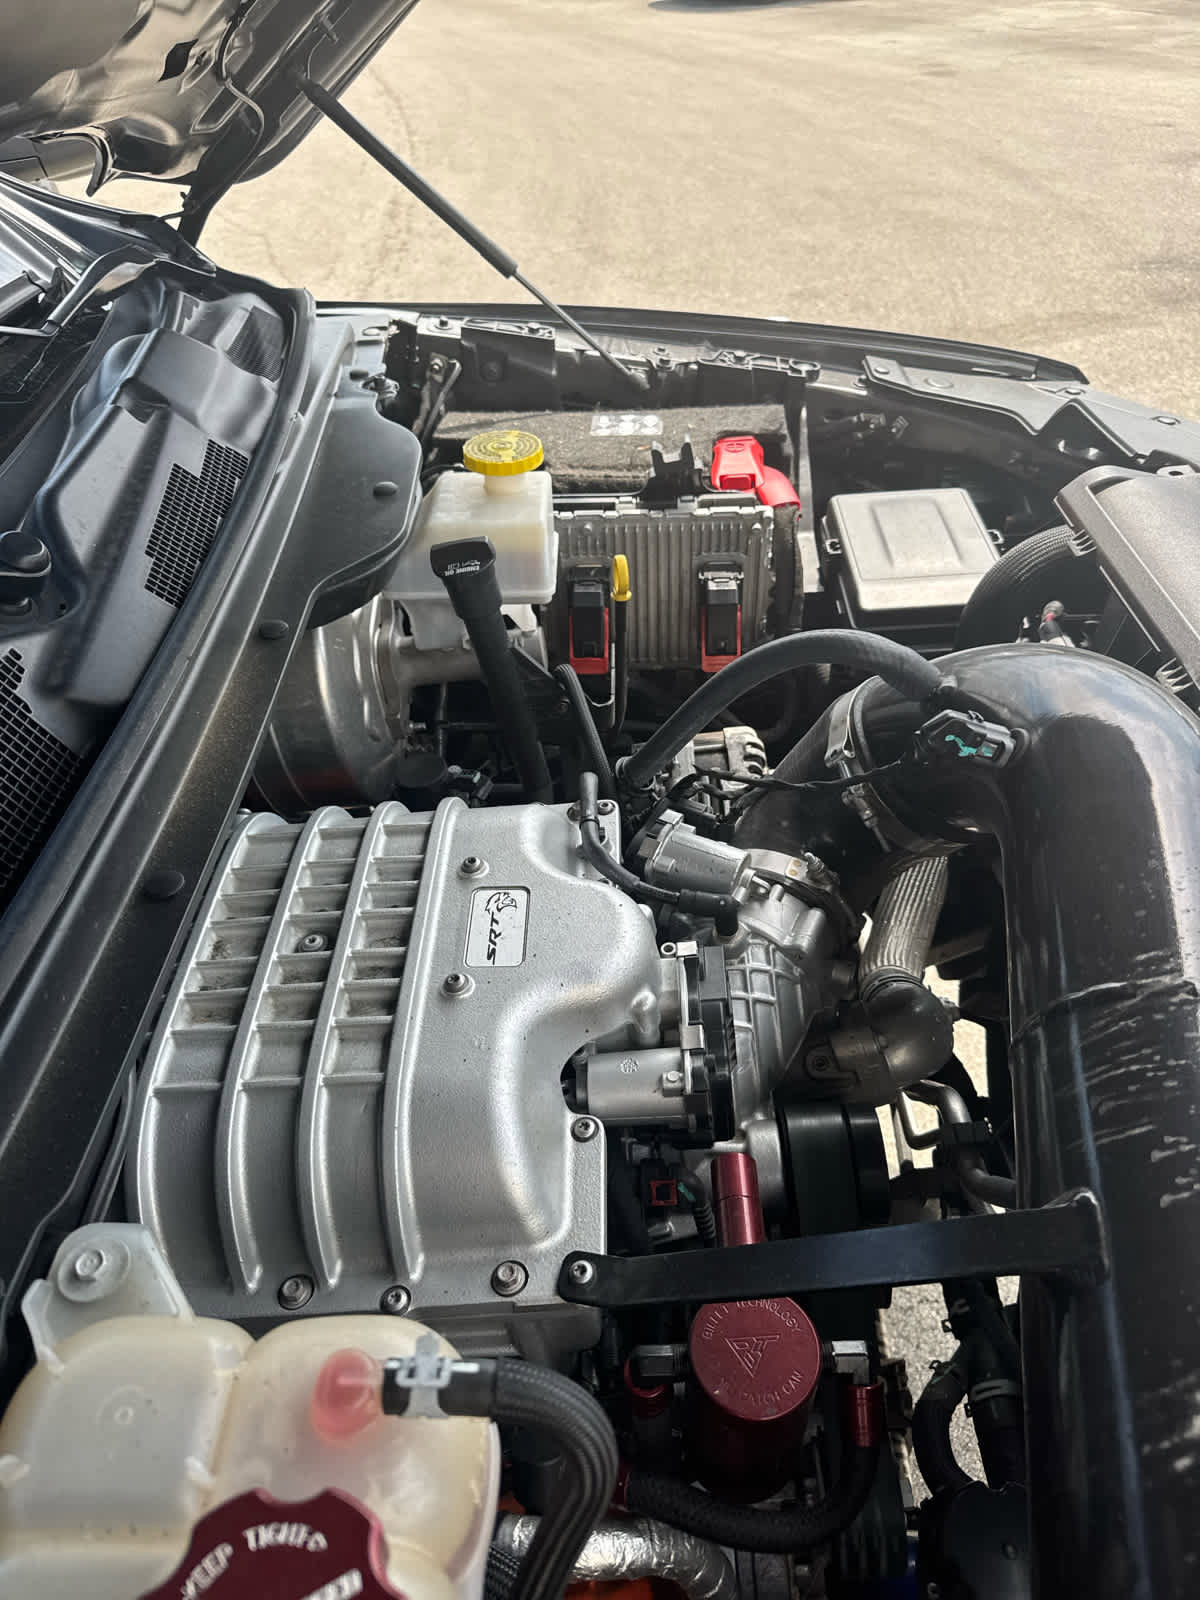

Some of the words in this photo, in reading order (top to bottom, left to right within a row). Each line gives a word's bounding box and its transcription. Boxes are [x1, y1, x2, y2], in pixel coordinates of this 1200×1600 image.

[486, 911, 502, 966] SRT
[735, 1299, 804, 1333] TECHNOLOGY
[781, 1369, 804, 1395] CAN
